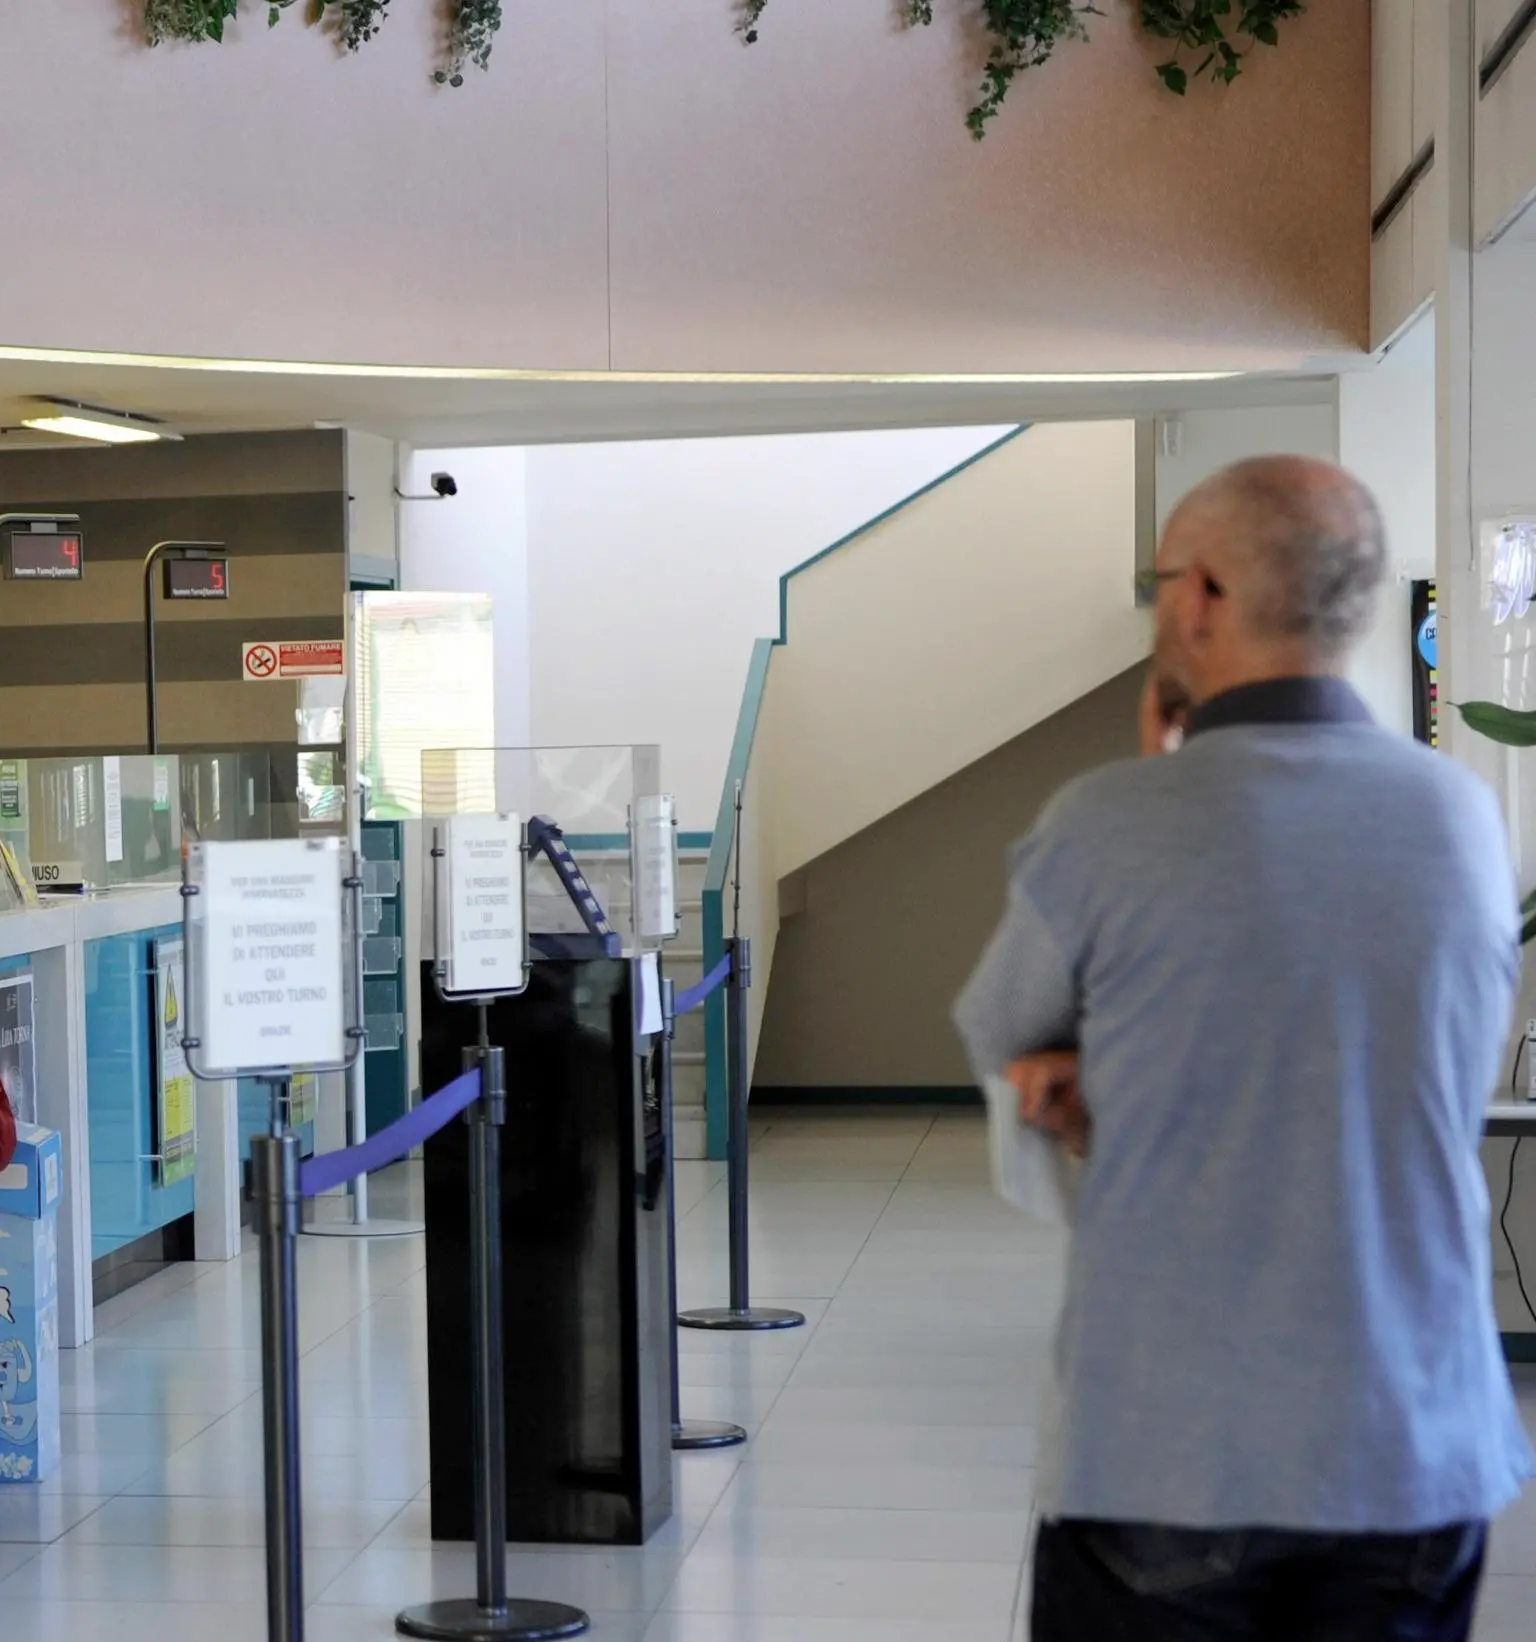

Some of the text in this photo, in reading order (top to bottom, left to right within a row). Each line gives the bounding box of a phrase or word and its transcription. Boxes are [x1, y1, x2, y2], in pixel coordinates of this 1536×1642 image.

[63, 539, 76, 567] 4
[212, 564, 224, 589] 5
[280, 642, 341, 652] VIETATO FUMARE
[32, 865, 60, 881] IUSO
[232, 921, 317, 939] VI PREGHIAMO
[233, 943, 316, 961] DI ATTENDERE
[238, 990, 284, 1005] VOSTRO
[287, 986, 326, 1003] TURNO
